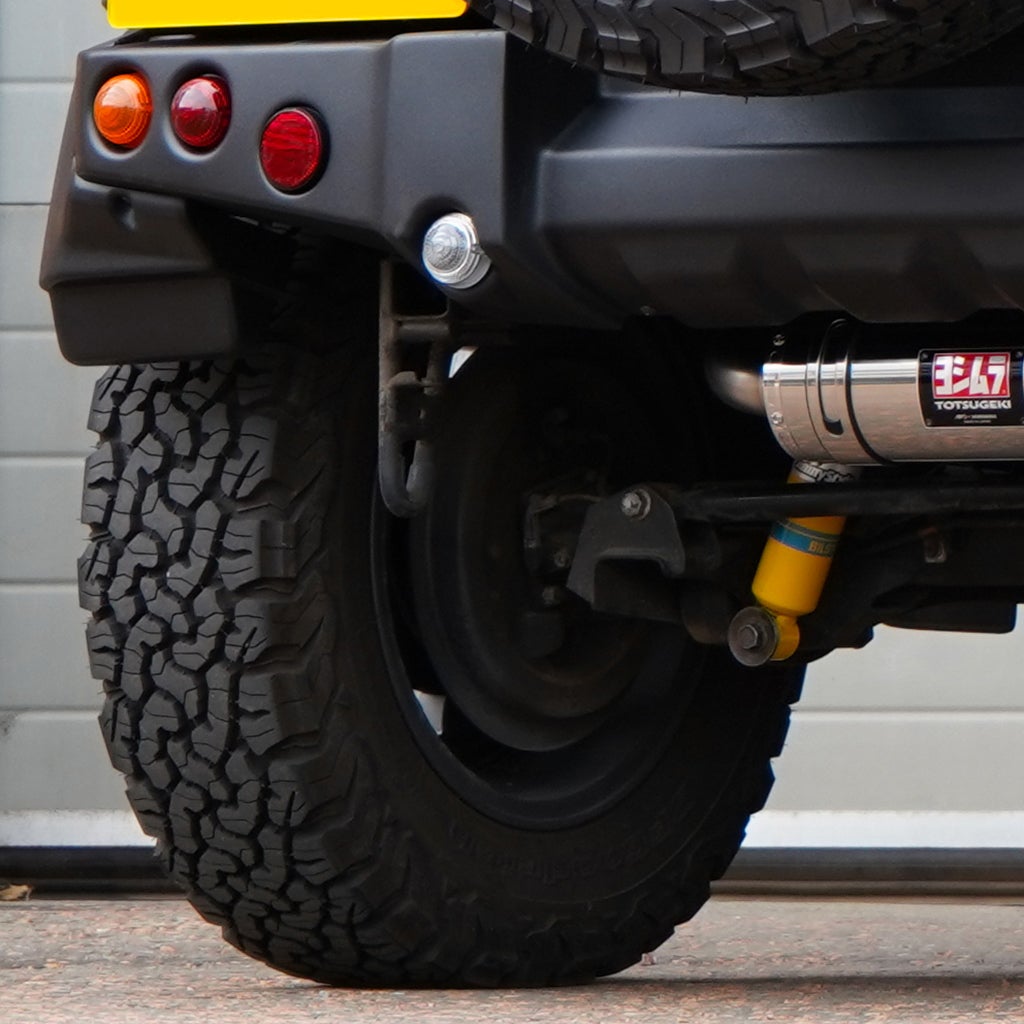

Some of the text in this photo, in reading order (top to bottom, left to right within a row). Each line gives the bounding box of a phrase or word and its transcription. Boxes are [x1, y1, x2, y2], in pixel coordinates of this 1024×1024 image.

[935, 356, 1006, 395] ヨシムラ
[934, 400, 1011, 410] TOTSUGEKI
